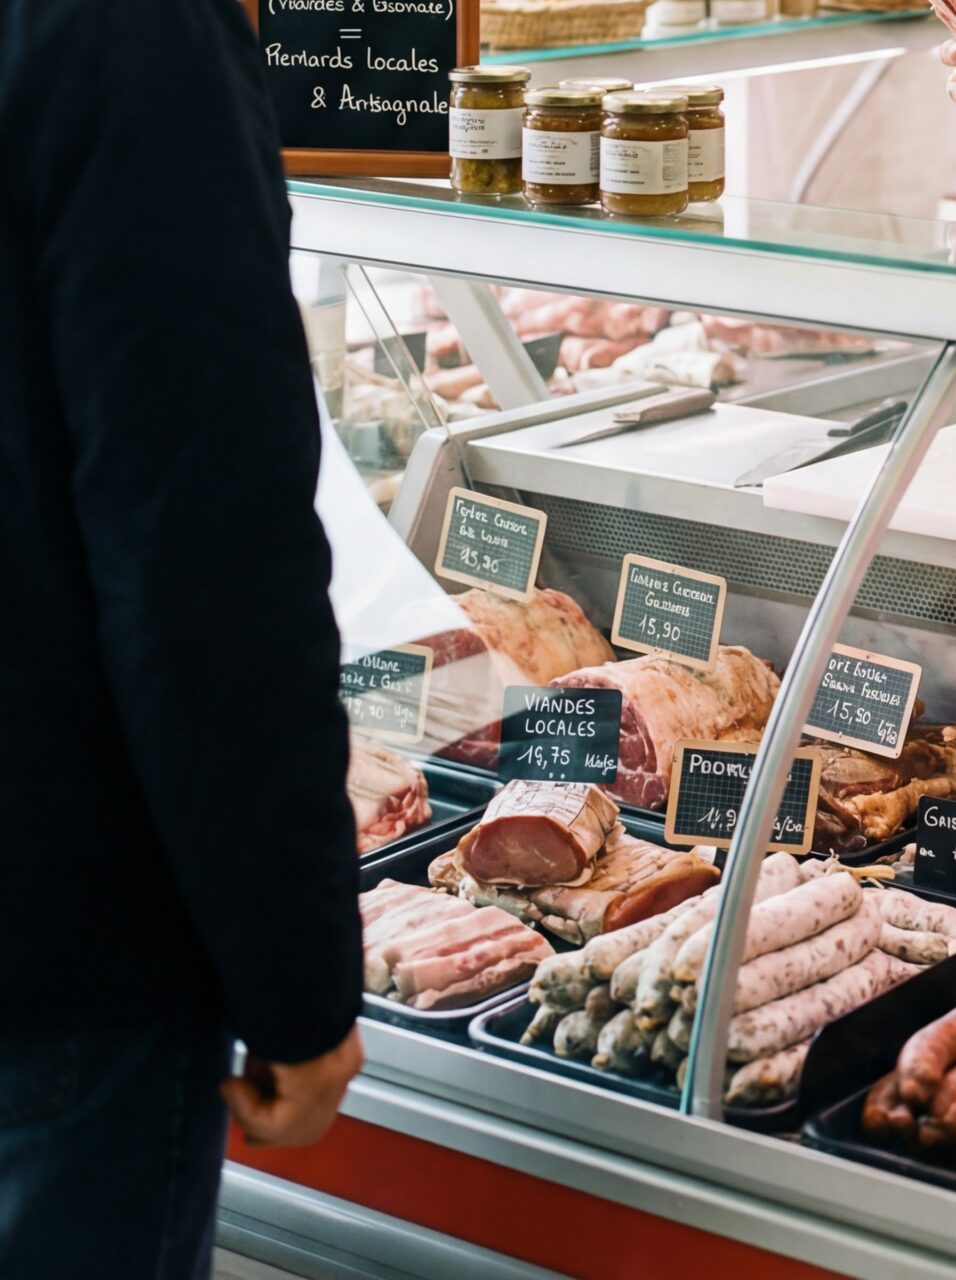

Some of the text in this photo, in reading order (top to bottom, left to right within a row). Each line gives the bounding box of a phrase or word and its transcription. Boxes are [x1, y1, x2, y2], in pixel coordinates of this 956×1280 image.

[310, 86, 327, 109] &
[639, 614, 681, 641] 15,90
[524, 693, 596, 715] VIANDES
[525, 718, 596, 738] LOCALES
